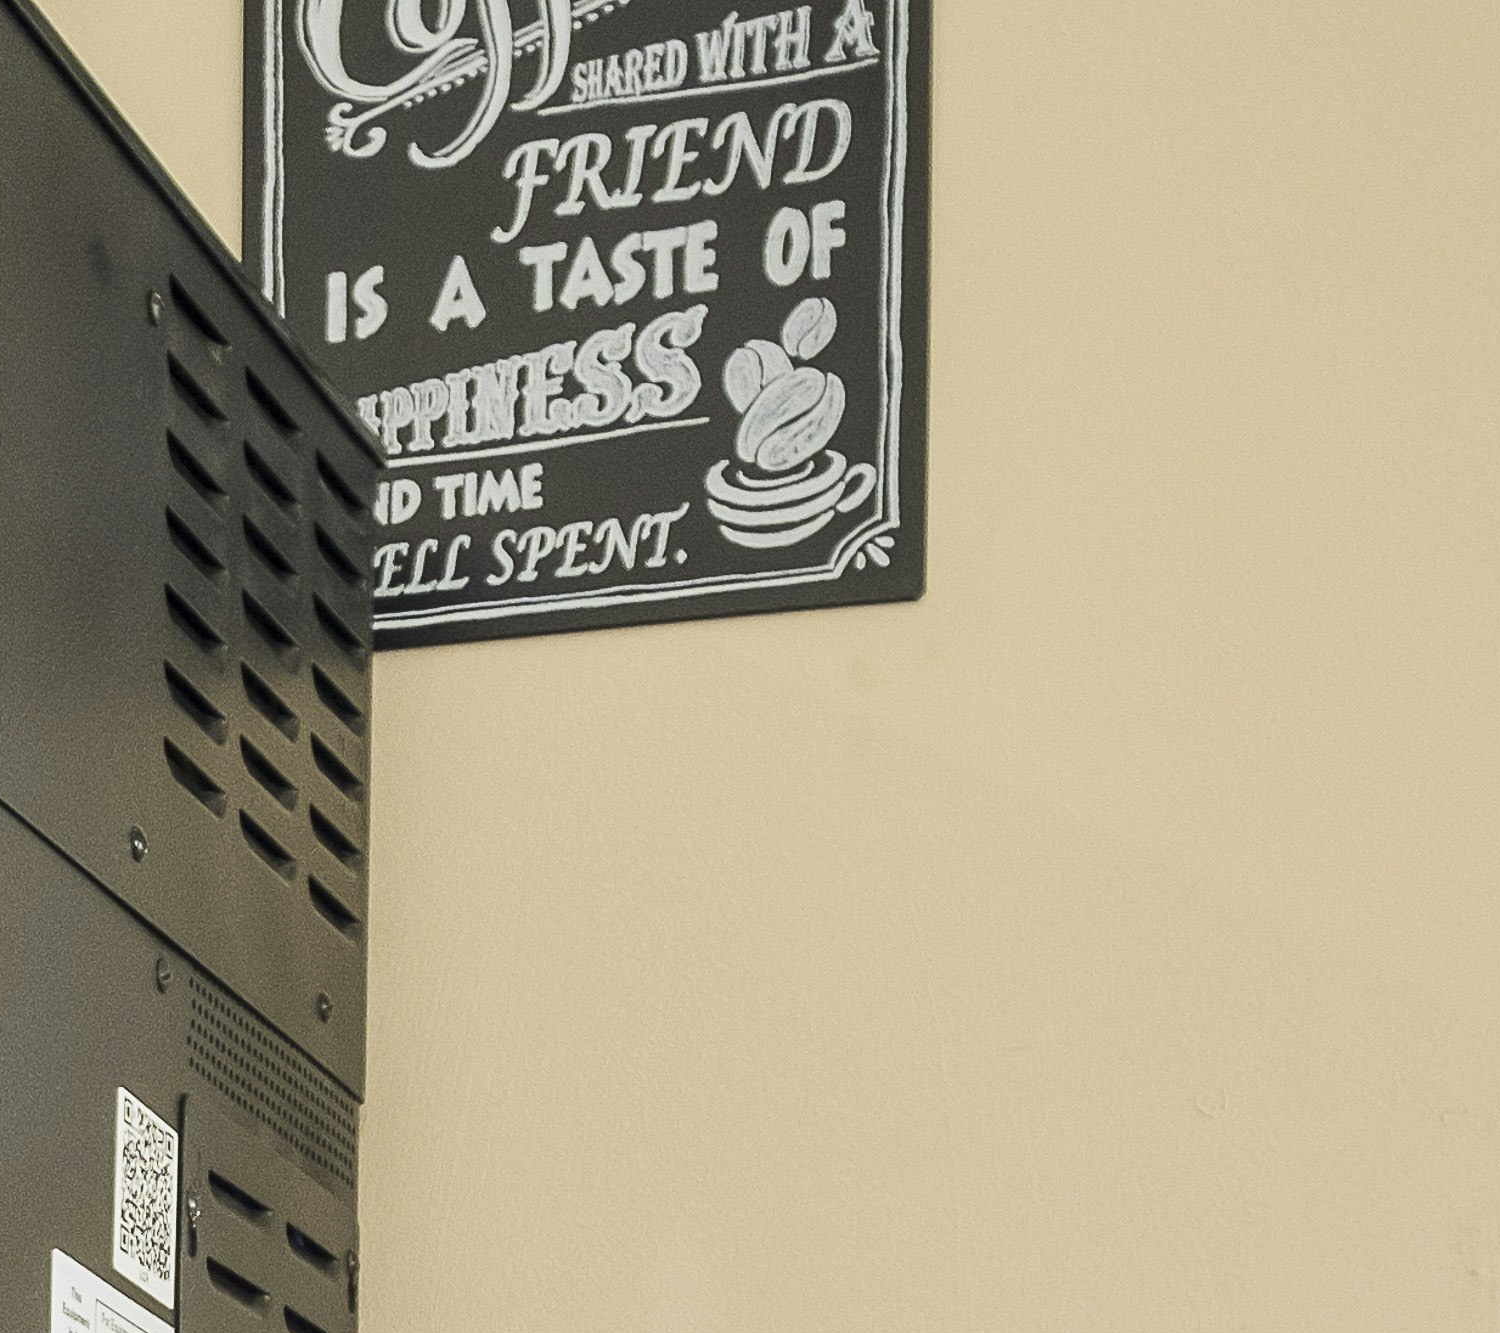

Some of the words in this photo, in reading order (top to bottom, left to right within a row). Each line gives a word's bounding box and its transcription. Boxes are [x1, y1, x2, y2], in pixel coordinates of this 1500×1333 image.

[571, 39, 688, 105] SHARED
[696, 8, 811, 84] WITH
[824, 0, 881, 61] A
[491, 98, 853, 244] FRIEND
[325, 265, 388, 343] IS
[430, 255, 487, 331] A
[520, 220, 719, 311] TASTE
[764, 200, 847, 286] OF
[356, 304, 709, 455] PPINESS
[373, 534, 472, 598] ELL
[486, 502, 690, 587] SPENT.
[374, 478, 422, 526] ND
[433, 462, 544, 520] TIME
